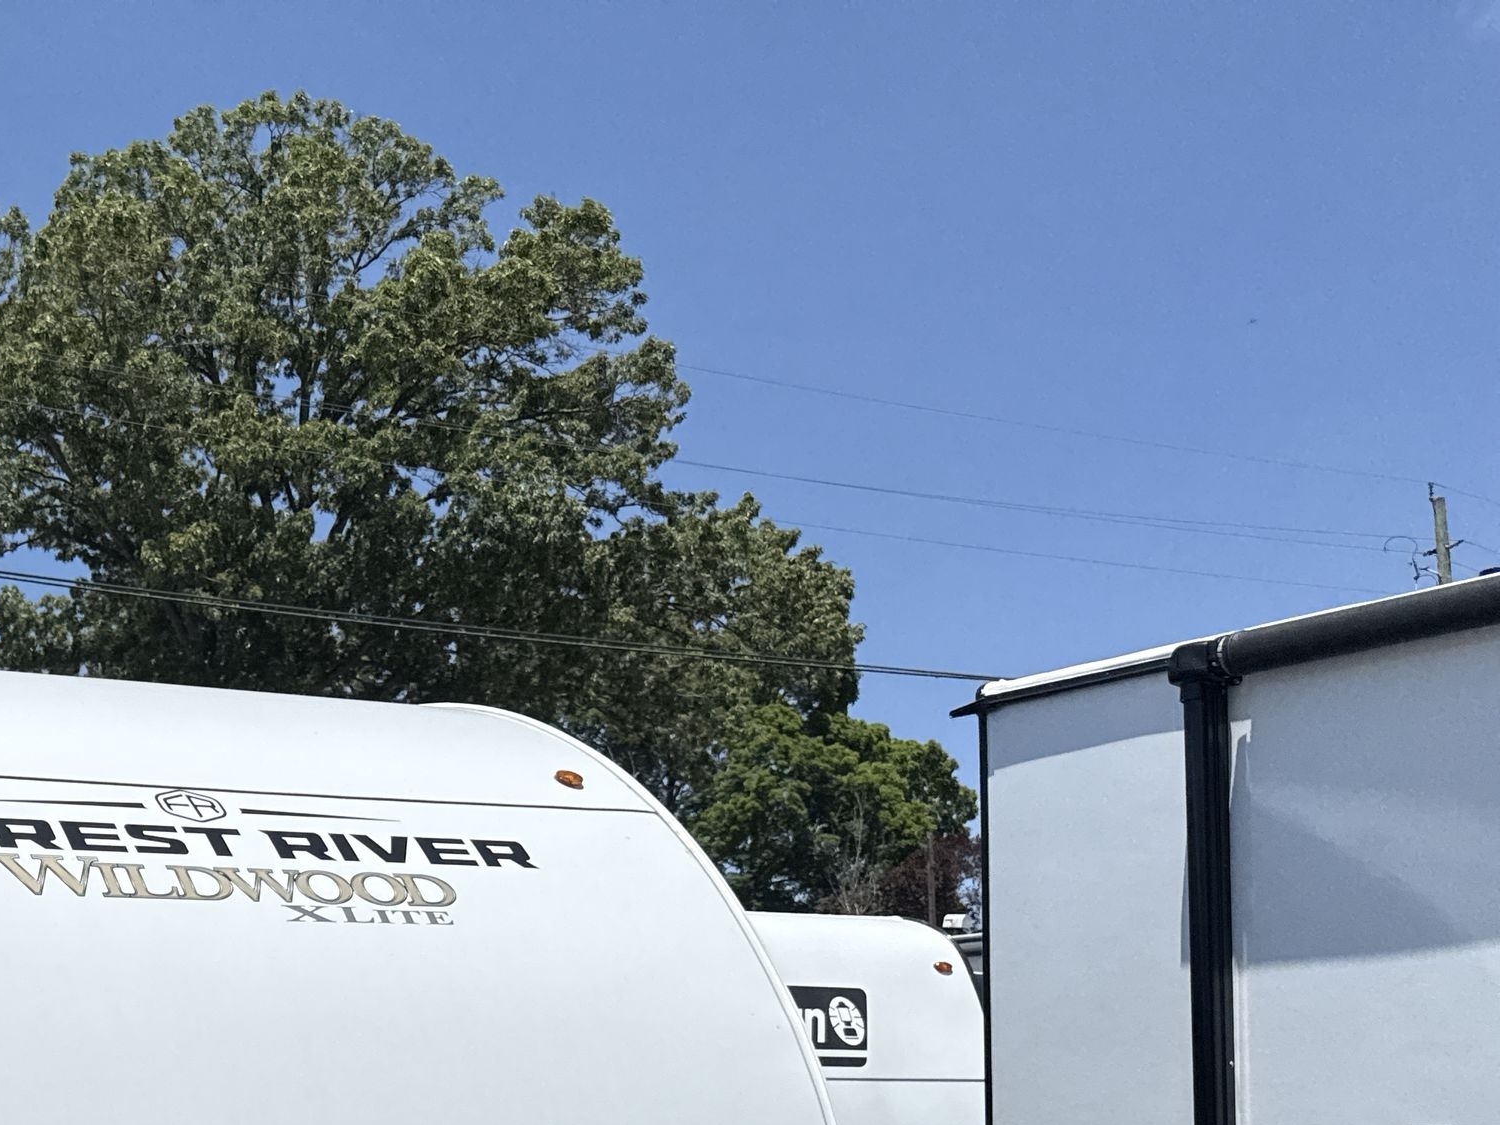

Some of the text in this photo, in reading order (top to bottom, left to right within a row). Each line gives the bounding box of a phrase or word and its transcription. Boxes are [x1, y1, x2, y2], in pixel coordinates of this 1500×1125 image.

[258, 828, 541, 869] RIVER
[284, 904, 455, 926] X LITE
